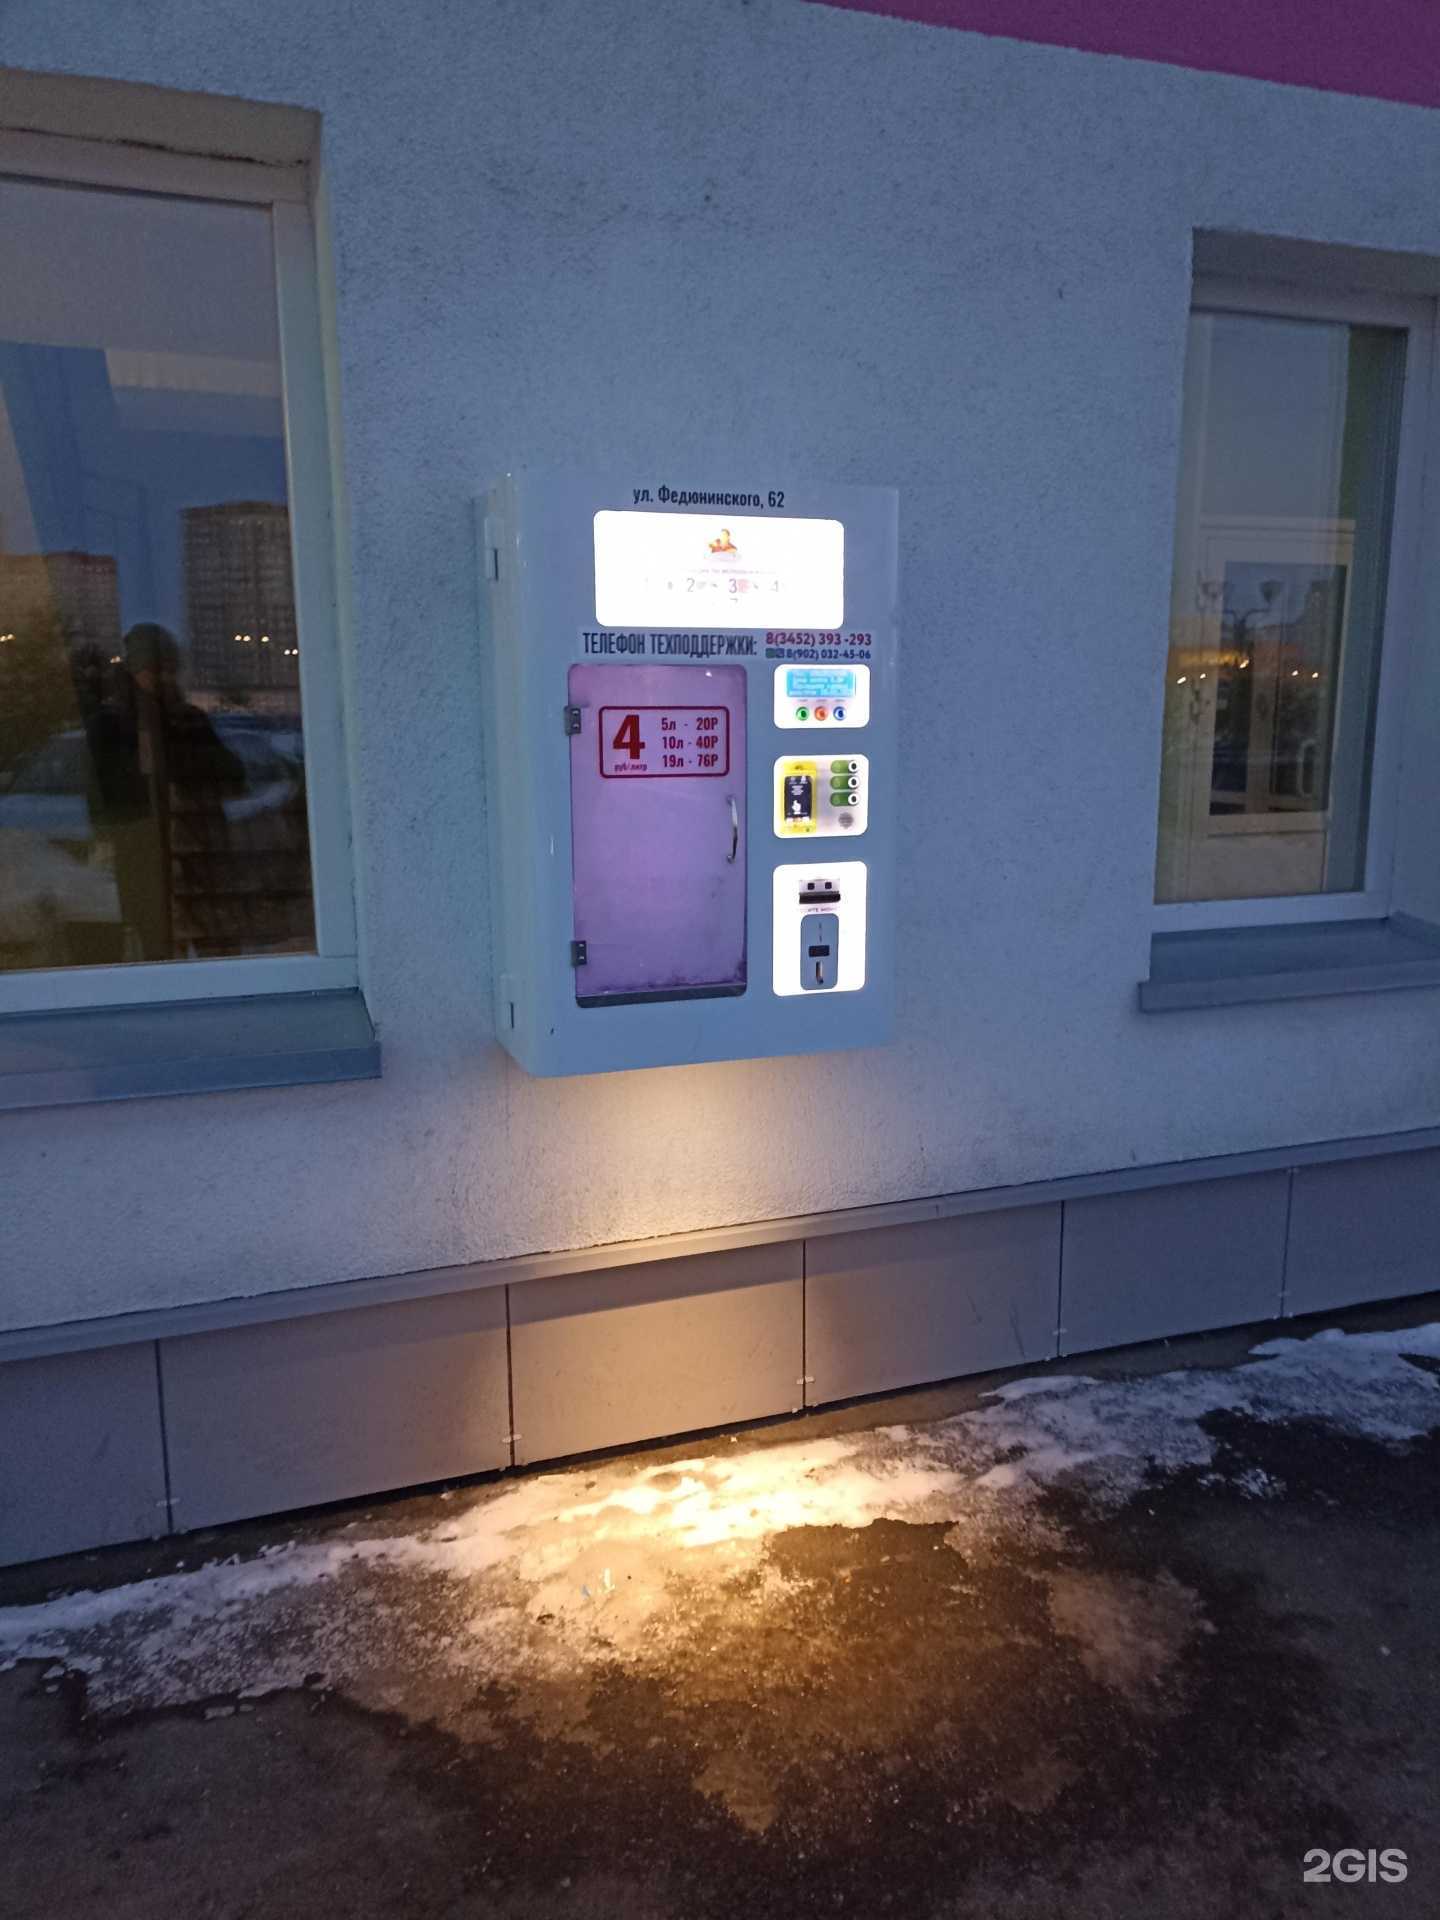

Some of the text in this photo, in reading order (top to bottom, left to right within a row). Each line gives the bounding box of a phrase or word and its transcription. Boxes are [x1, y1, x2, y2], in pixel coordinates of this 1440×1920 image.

[633, 484, 785, 509] ул. Федюнинского, 62
[582, 632, 758, 658] ТЕЛЕФОН ТЕХПОДДЕРЖКИ:
[766, 632, 816, 648] 8(3452)
[819, 633, 841, 645] 393
[787, 649, 819, 661] 8(902)
[661, 717, 676, 731] 5л
[696, 717, 718, 731] 20Р
[612, 714, 646, 760] 4
[662, 736, 684, 750] 10л
[696, 735, 718, 749] 40Р
[662, 754, 684, 768] 19л
[697, 754, 719, 767] 76Р
